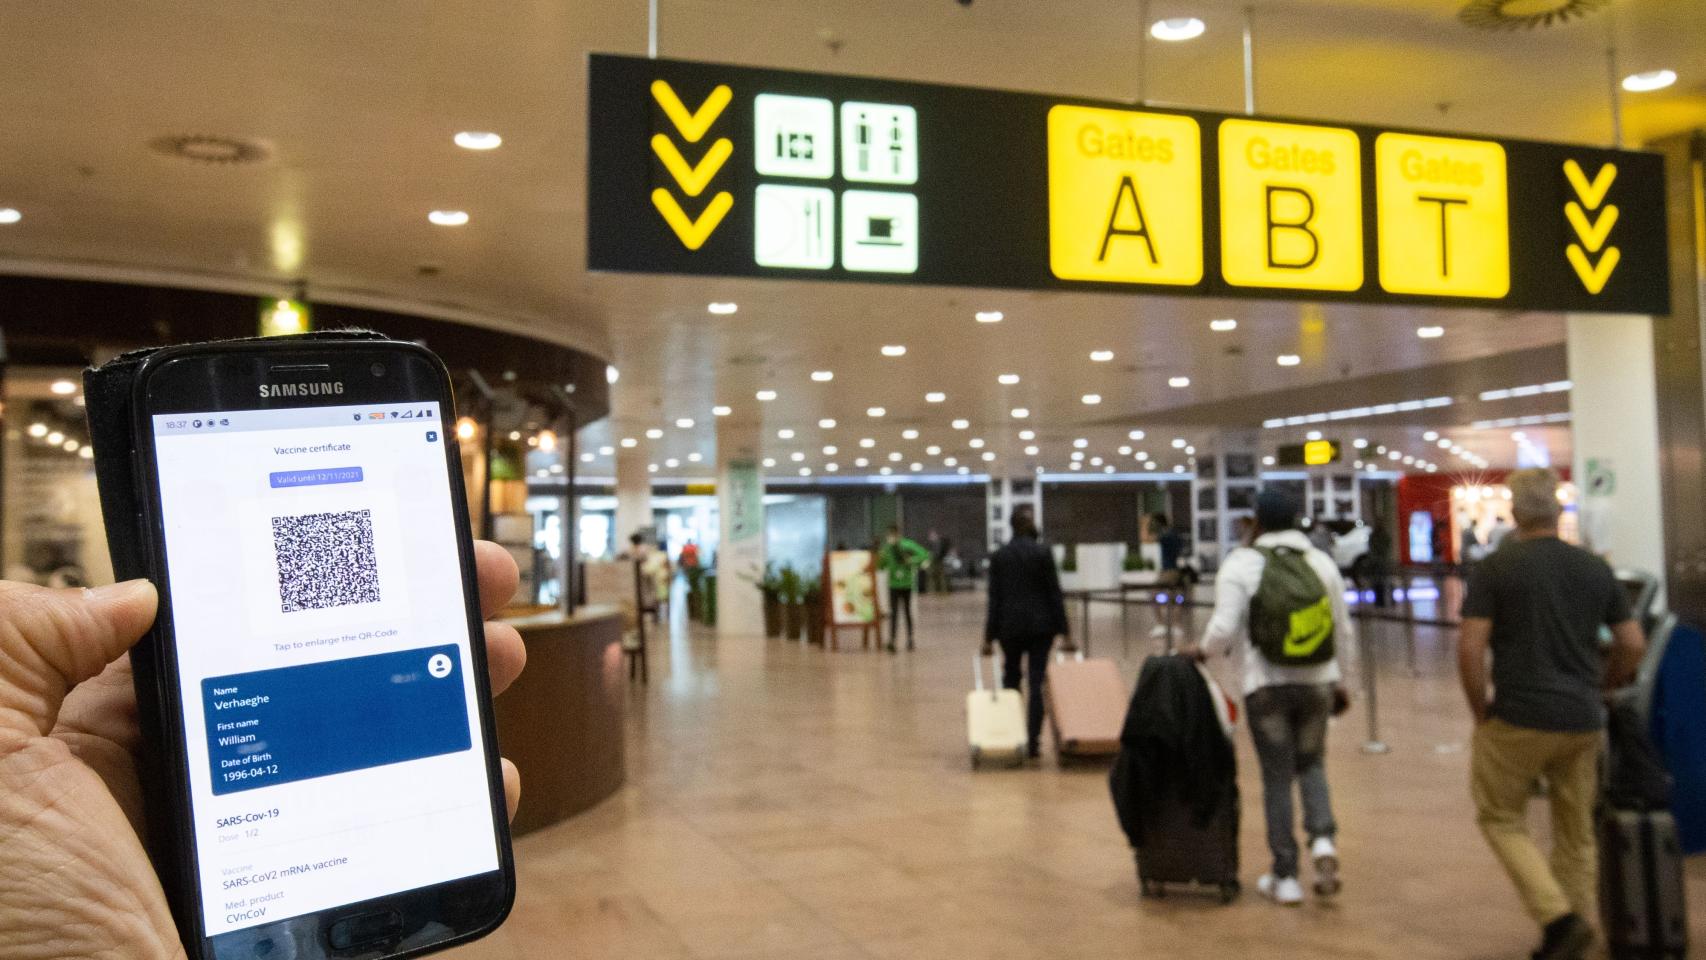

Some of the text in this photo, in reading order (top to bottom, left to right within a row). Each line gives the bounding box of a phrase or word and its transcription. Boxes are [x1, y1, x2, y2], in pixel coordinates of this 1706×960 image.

[1077, 122, 1176, 164] Gates
[1244, 136, 1336, 177] Gates
[1399, 148, 1484, 189] Gates
[1097, 175, 1159, 265] A
[1265, 185, 1320, 270] B
[1417, 196, 1468, 278] T
[259, 380, 345, 398] SAMSUNG
[274, 442, 351, 455] Vaccine certificate
[277, 471, 360, 484] Valid until 12/11/2021
[274, 628, 398, 653] Tap to enlarge the QR-Code
[213, 686, 238, 696] Name
[214, 694, 270, 711] Verhaeghe
[217, 719, 259, 732] First name
[218, 733, 256, 746] William
[221, 752, 272, 768] Date of Birth
[223, 764, 278, 782] 1996-04-12
[216, 808, 280, 829] SARS-Cov-19
[218, 828, 259, 844] Dose 1/2
[221, 862, 254, 876] Vaccine
[222, 855, 348, 890] SARS-CoV2 mRNA vaccine
[225, 890, 284, 911] Med. product
[226, 906, 267, 924] CVnCoV
